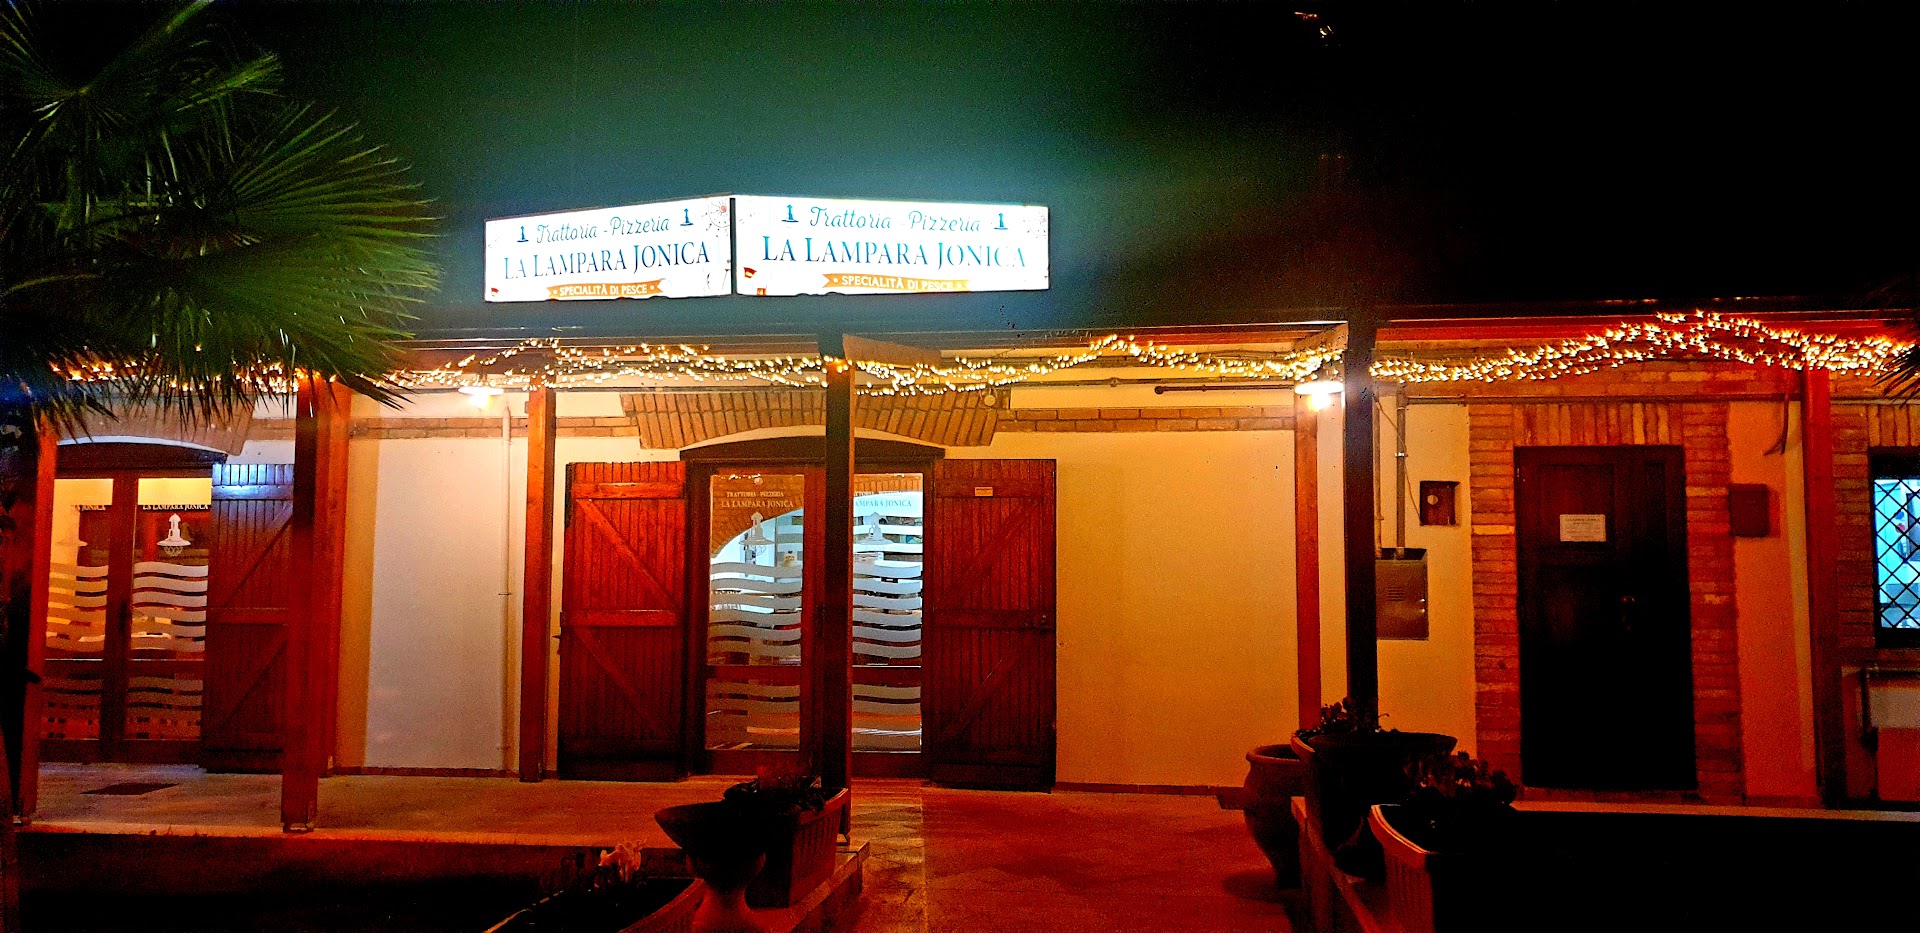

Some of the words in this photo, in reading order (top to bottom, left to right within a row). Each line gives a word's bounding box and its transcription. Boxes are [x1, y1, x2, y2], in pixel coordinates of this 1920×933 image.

[536, 224, 598, 244] Trattoria
[609, 216, 670, 237] Pizzeria
[810, 206, 892, 229] Trattoria
[908, 210, 981, 232] Pizzeria
[504, 257, 527, 280] LA
[533, 249, 627, 277] LAMPARA
[633, 241, 710, 274] JONICA
[762, 235, 797, 262] LA
[804, 237, 928, 266] LAMPARA
[937, 242, 1026, 270] JONICA
[559, 283, 607, 297] SPECIALITÀ
[610, 285, 619, 295] DI
[621, 284, 648, 295] PESCE
[841, 275, 904, 289] SPECIALITÀ
[907, 279, 918, 290] DI
[922, 281, 953, 291] PESCE
